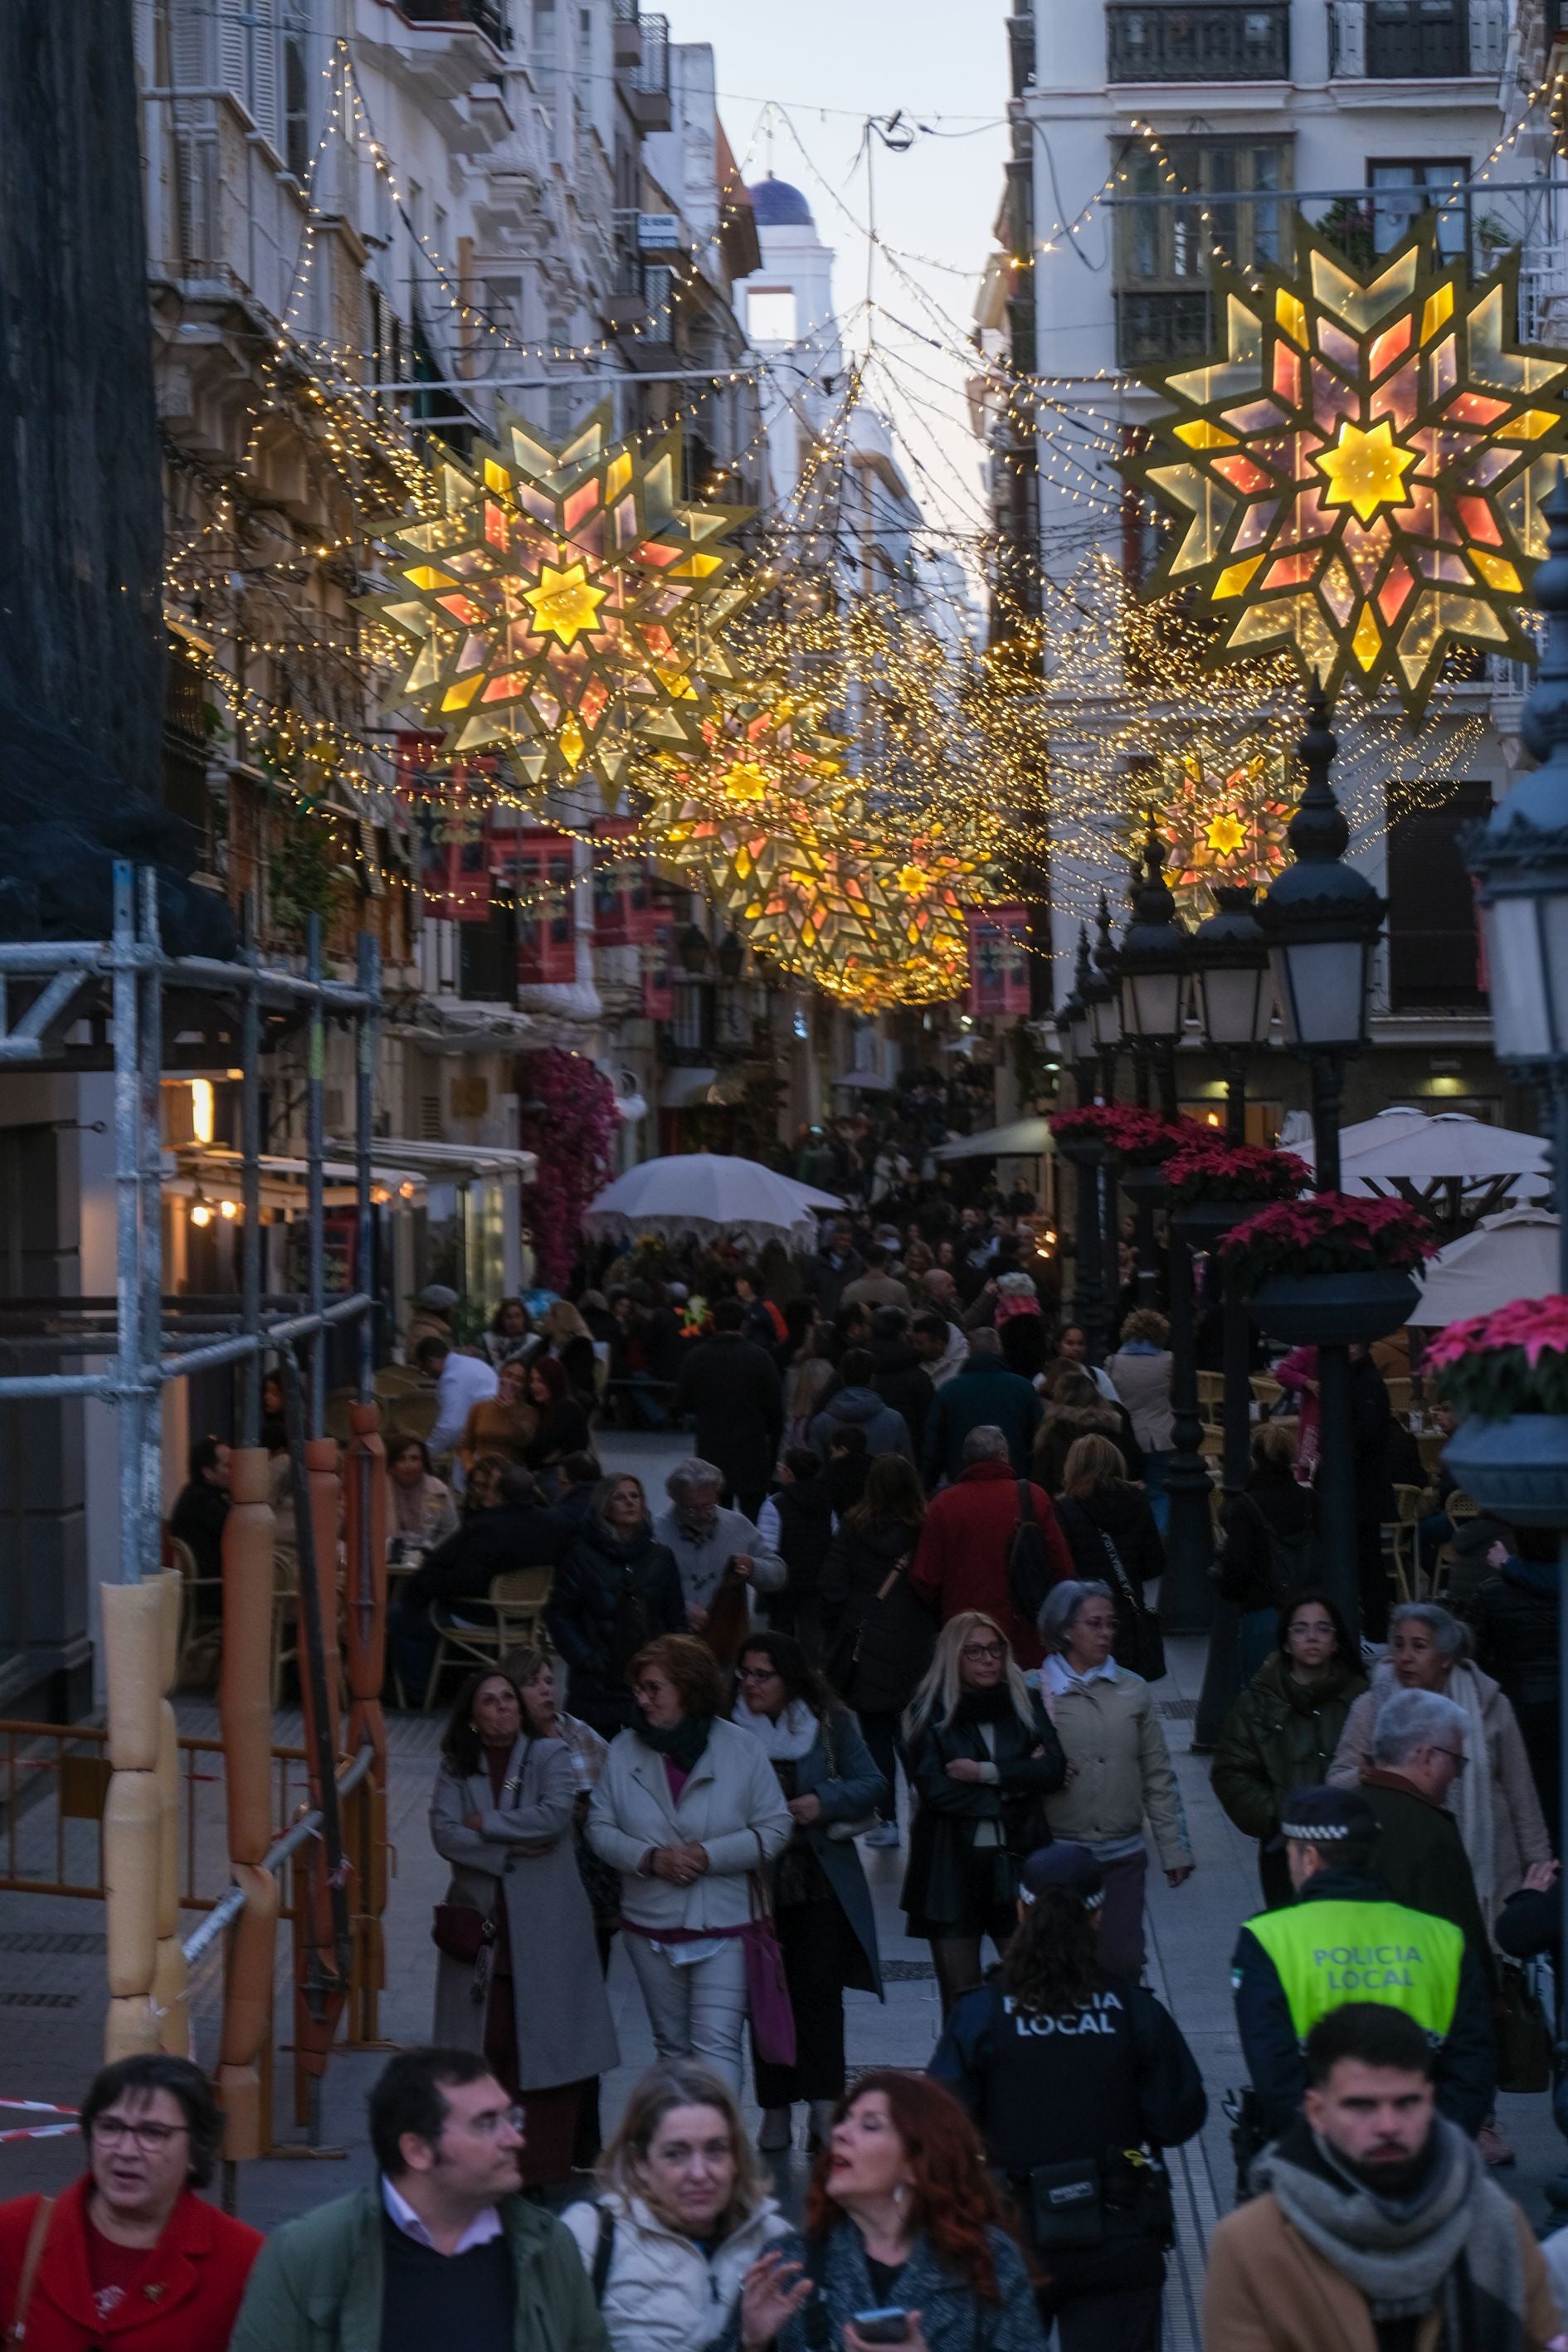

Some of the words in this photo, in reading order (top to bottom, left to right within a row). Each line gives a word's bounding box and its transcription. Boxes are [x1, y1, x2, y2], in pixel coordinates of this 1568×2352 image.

[1313, 1945, 1424, 1967] POLICIA
[1328, 1968, 1415, 1989] LOCAL
[1016, 2013, 1116, 2036] LOCAL
